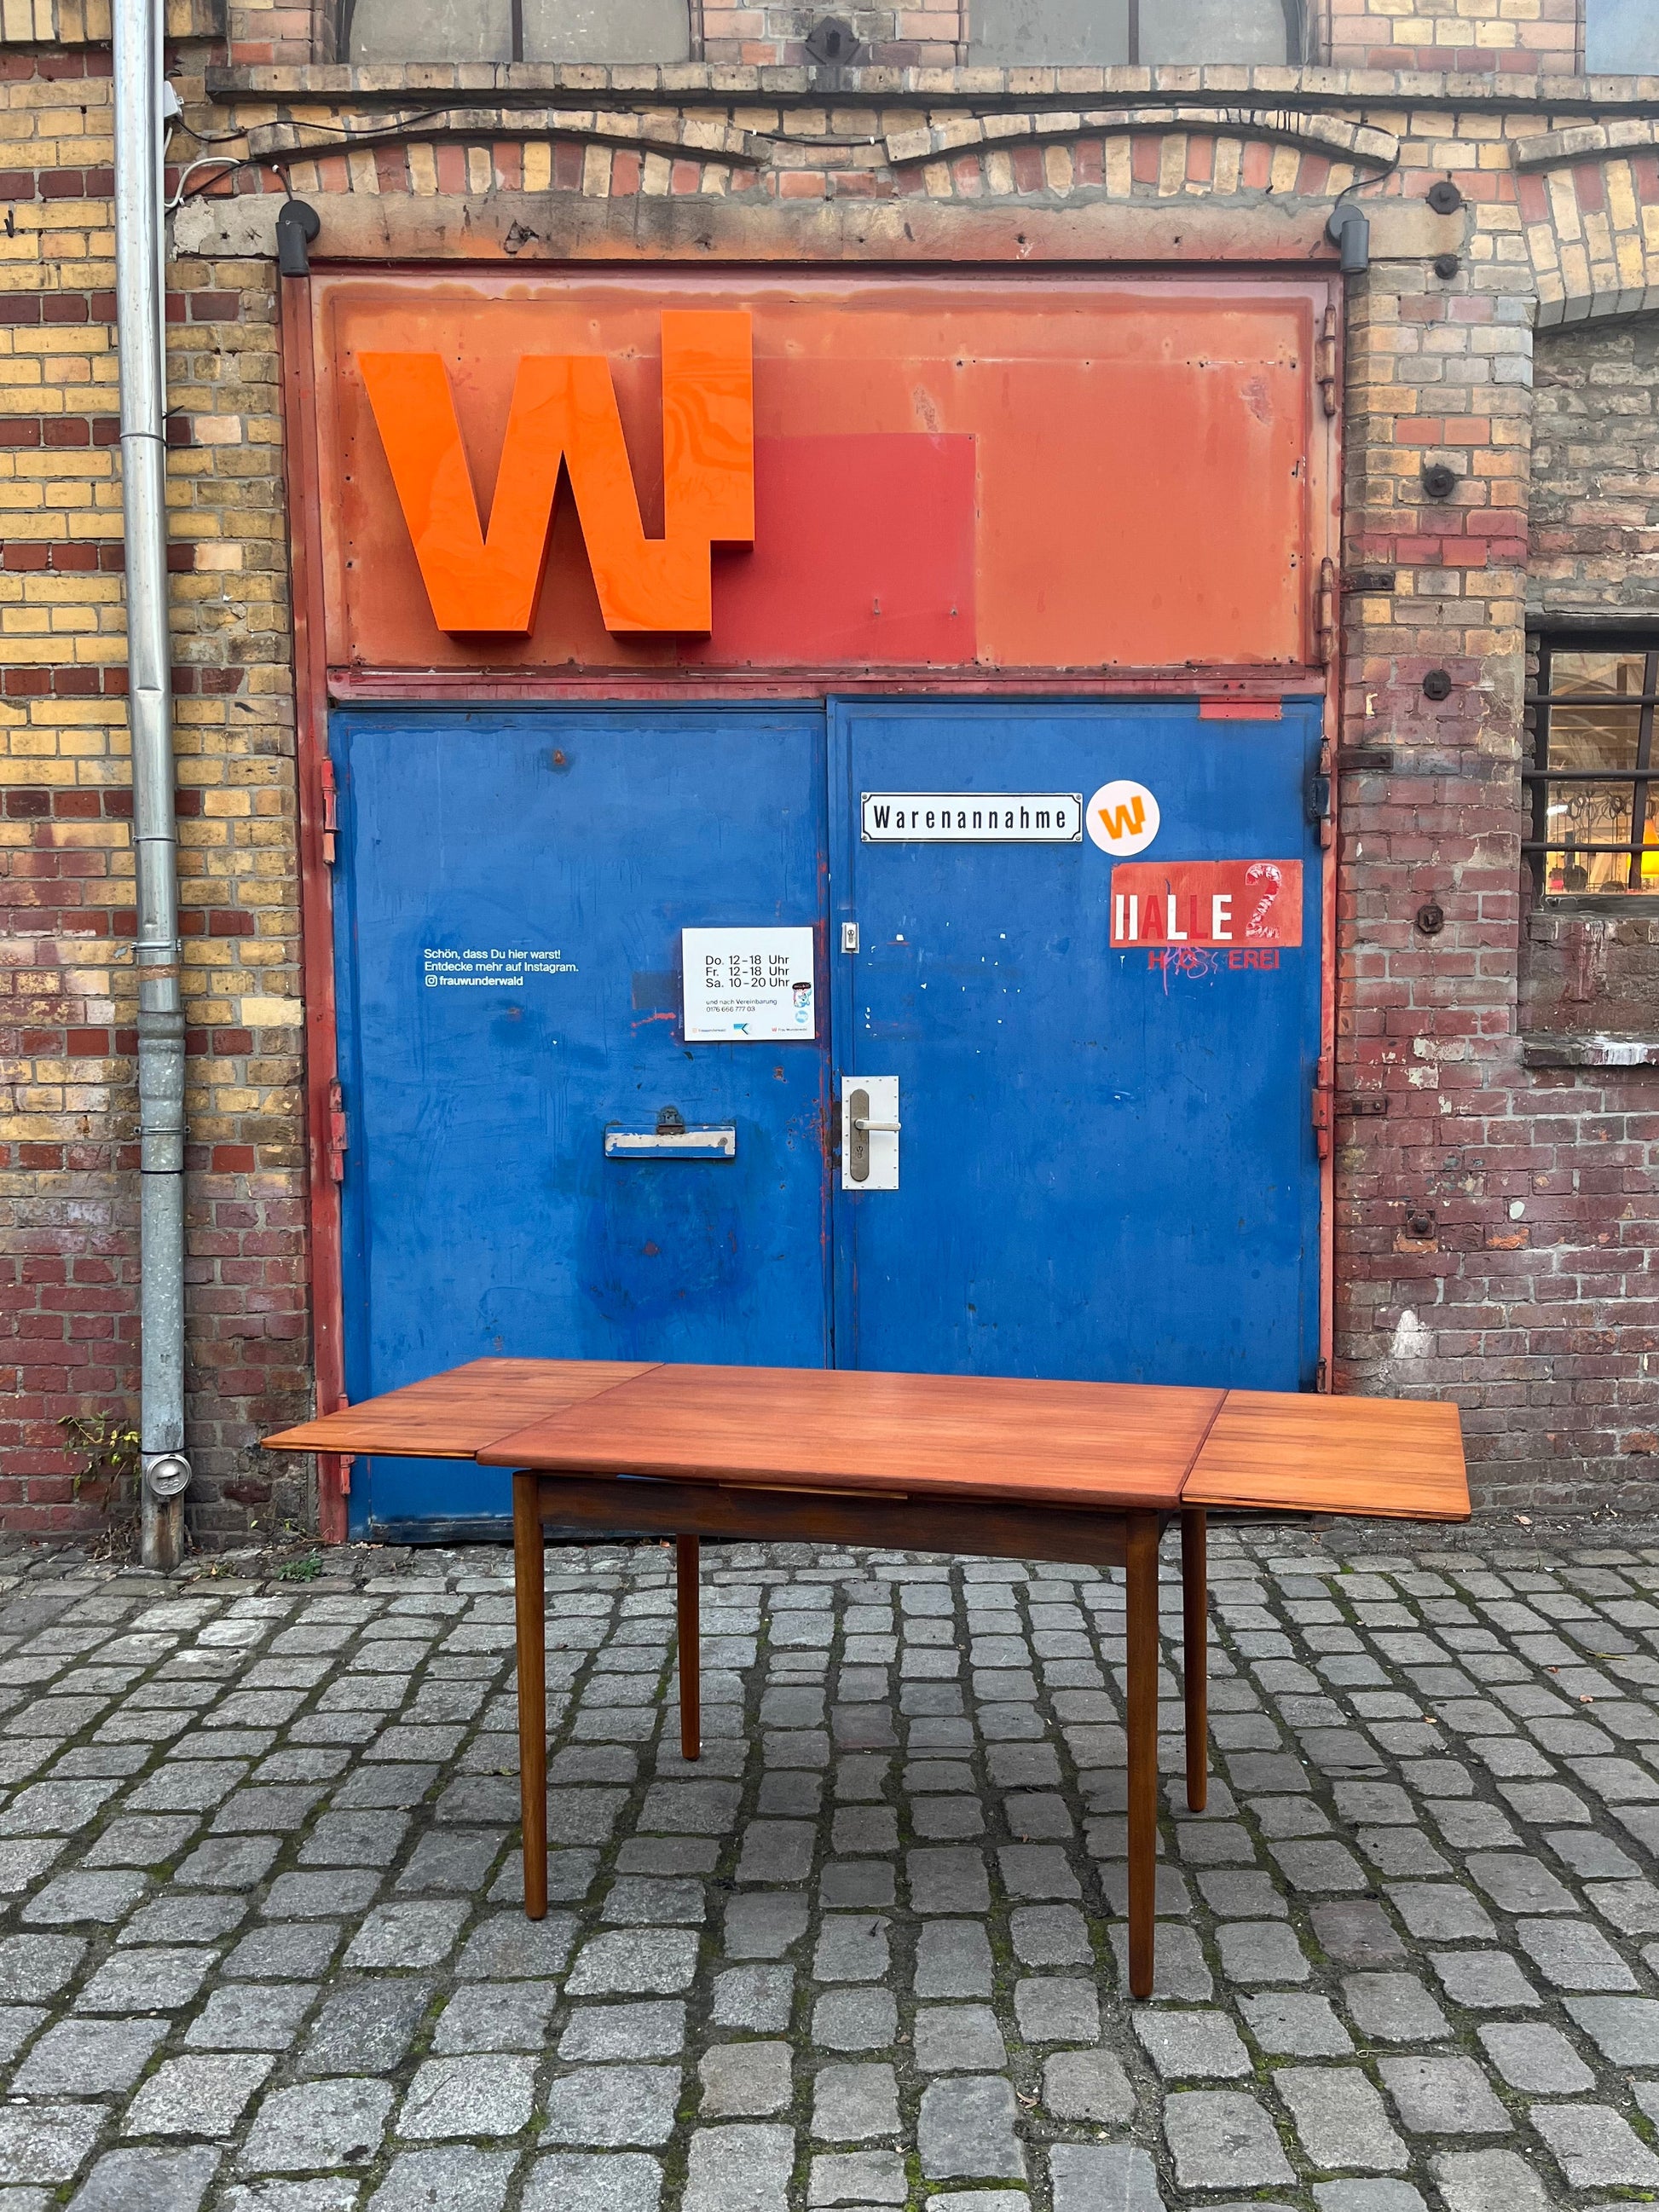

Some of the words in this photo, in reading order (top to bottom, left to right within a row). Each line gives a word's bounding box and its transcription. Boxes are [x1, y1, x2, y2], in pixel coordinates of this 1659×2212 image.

[357, 309, 755, 636] W
[872, 805, 1067, 829] Warenannahme
[1098, 795, 1147, 840] W
[1114, 894, 1233, 940] HALLE
[1245, 863, 1283, 939] 2
[424, 948, 460, 960] Schön,
[463, 950, 488, 959] dass
[490, 950, 506, 959] Du
[508, 949, 528, 959] hier
[530, 950, 561, 959] warst!
[706, 955, 725, 965] Do.
[769, 955, 789, 964] Uhr
[424, 961, 473, 971] Entdecke
[476, 962, 503, 972] mehr
[505, 962, 523, 972] auf
[524, 962, 579, 973] Instagram.
[706, 967, 719, 976] Fr.
[769, 966, 789, 975] Uhr
[439, 975, 523, 986] frauwunderwald
[706, 978, 724, 988] Sa.
[769, 978, 790, 987] Uhr
